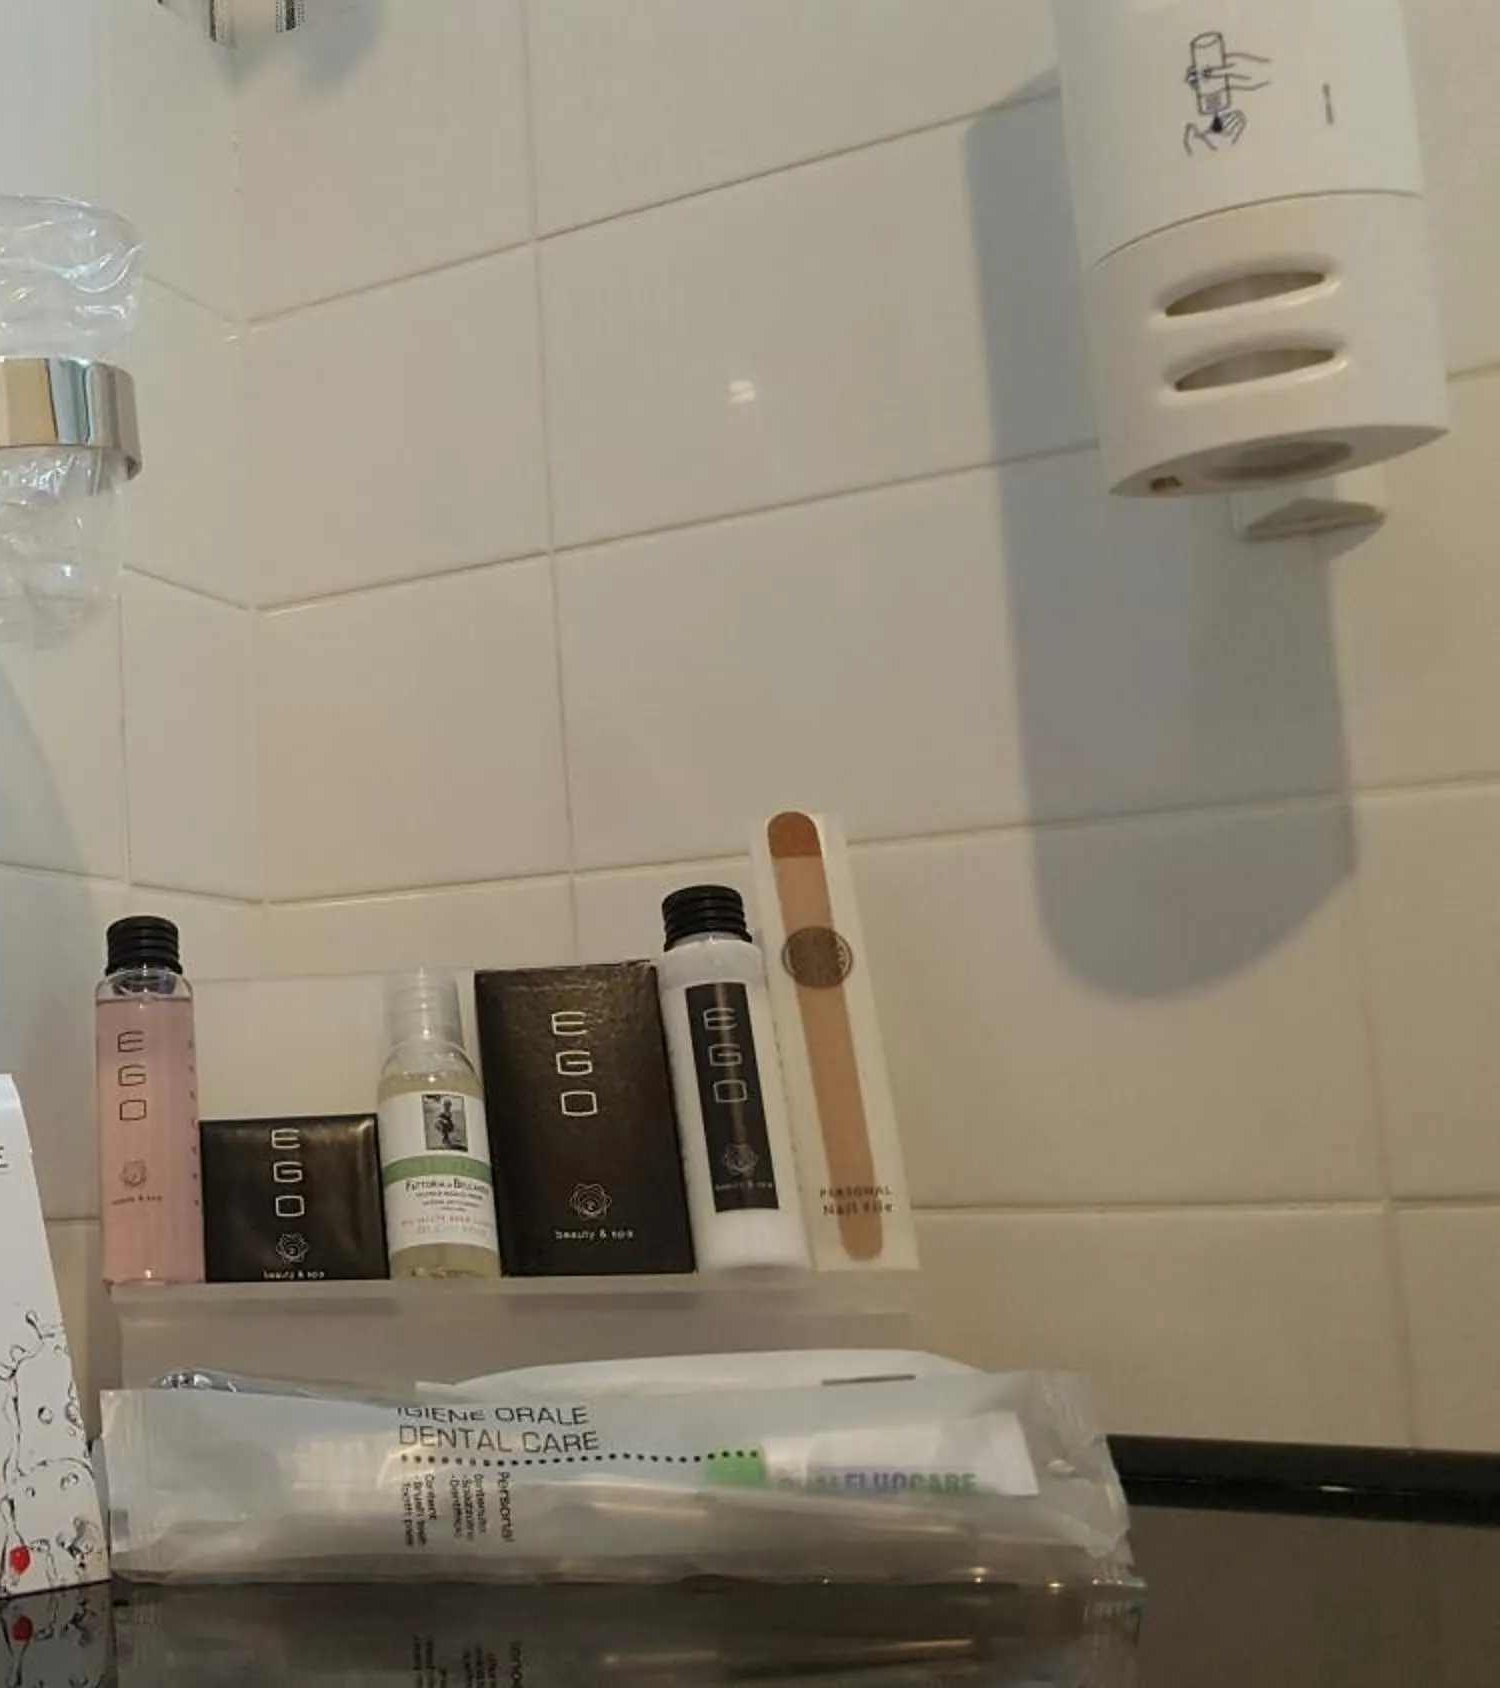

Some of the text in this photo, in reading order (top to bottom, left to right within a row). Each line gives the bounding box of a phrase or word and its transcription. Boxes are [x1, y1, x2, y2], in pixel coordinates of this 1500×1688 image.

[117, 1030, 147, 1121] EGO
[550, 1010, 598, 1117] EGO
[703, 1007, 748, 1103] EGO
[271, 1128, 306, 1218] EGO
[399, 1424, 600, 1454] DENTAL CARE
[495, 1405, 590, 1426] ORALE
